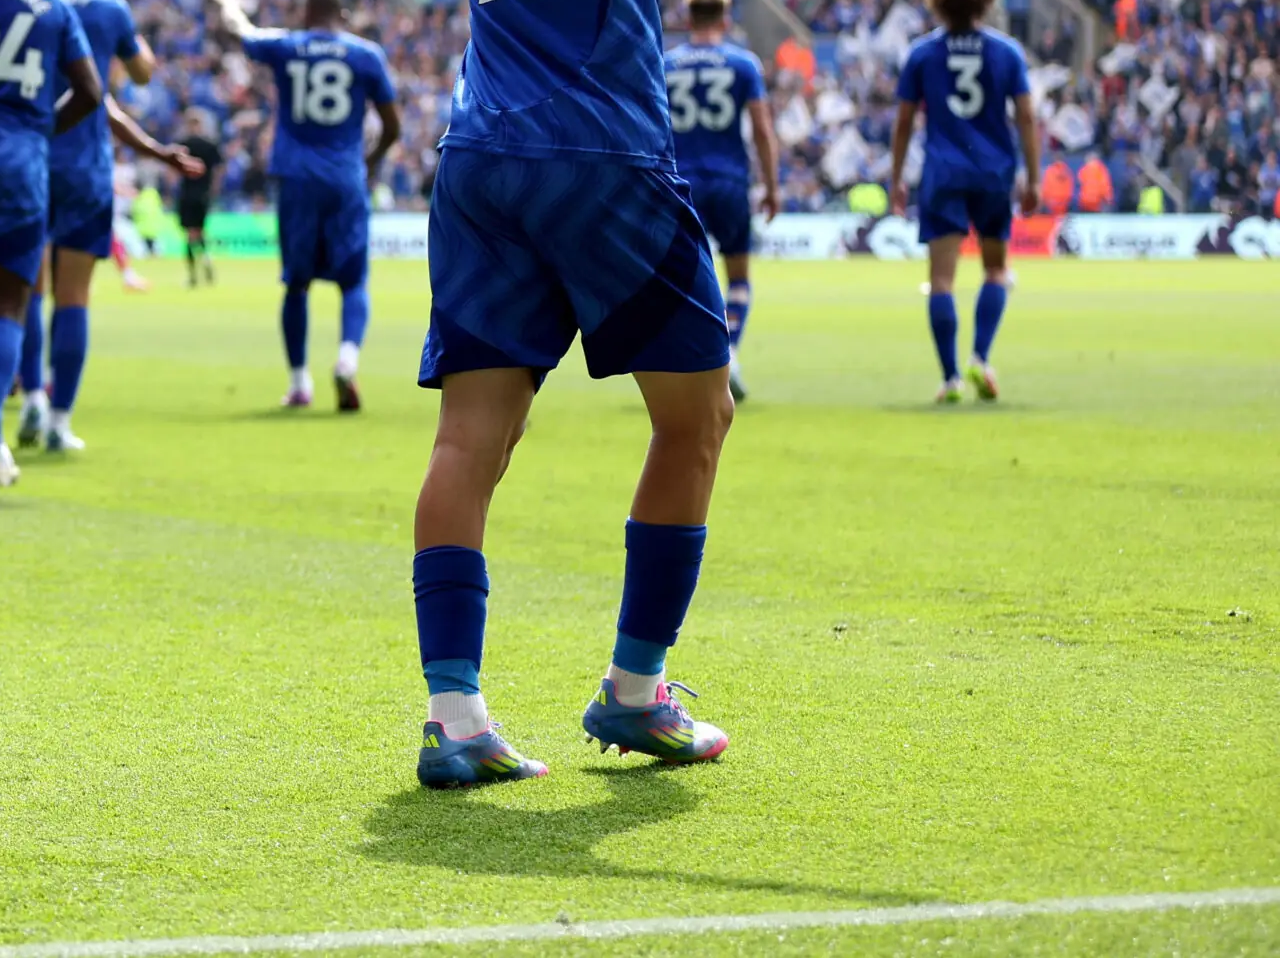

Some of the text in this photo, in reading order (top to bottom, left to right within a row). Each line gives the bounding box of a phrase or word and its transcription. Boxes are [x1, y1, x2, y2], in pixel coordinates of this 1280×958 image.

[286, 60, 353, 125] 18
[667, 67, 735, 133] 33
[947, 54, 984, 119] 3
